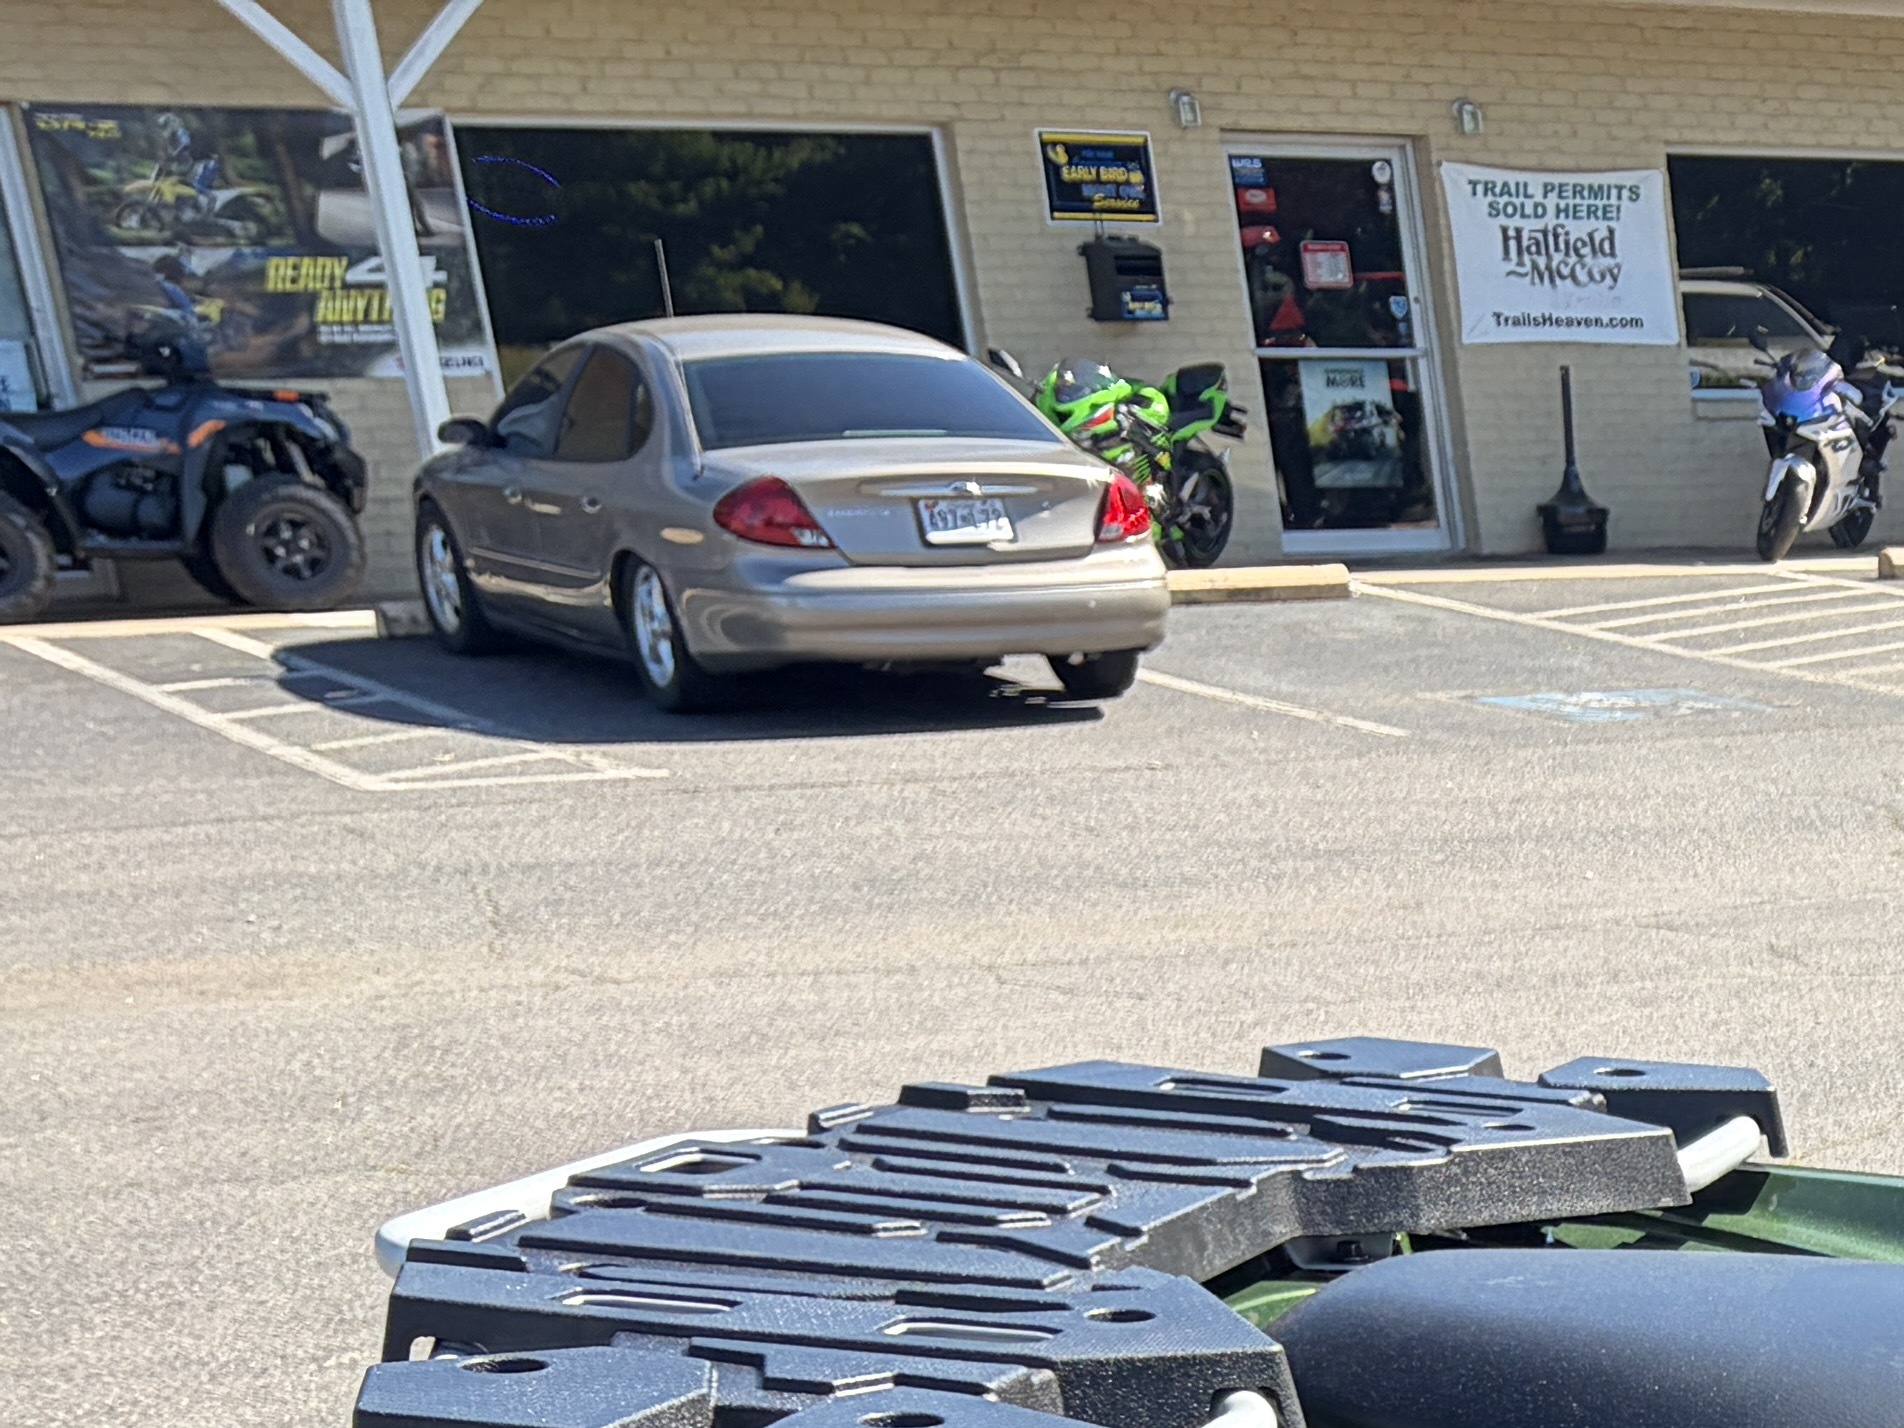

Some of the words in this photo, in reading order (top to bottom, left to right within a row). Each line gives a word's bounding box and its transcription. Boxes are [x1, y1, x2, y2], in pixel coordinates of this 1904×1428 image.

[1467, 179, 1535, 199] TRAIL
[1542, 181, 1641, 202] PERMITS
[1487, 200, 1548, 219] SOLD
[1554, 202, 1622, 222] HERE!
[1499, 222, 1617, 267] Hatfield
[266, 256, 348, 292] READY
[1529, 258, 1622, 290] McCoy
[315, 288, 446, 323] ANYTG
[1492, 311, 1644, 329] TrailsHeaven.com
